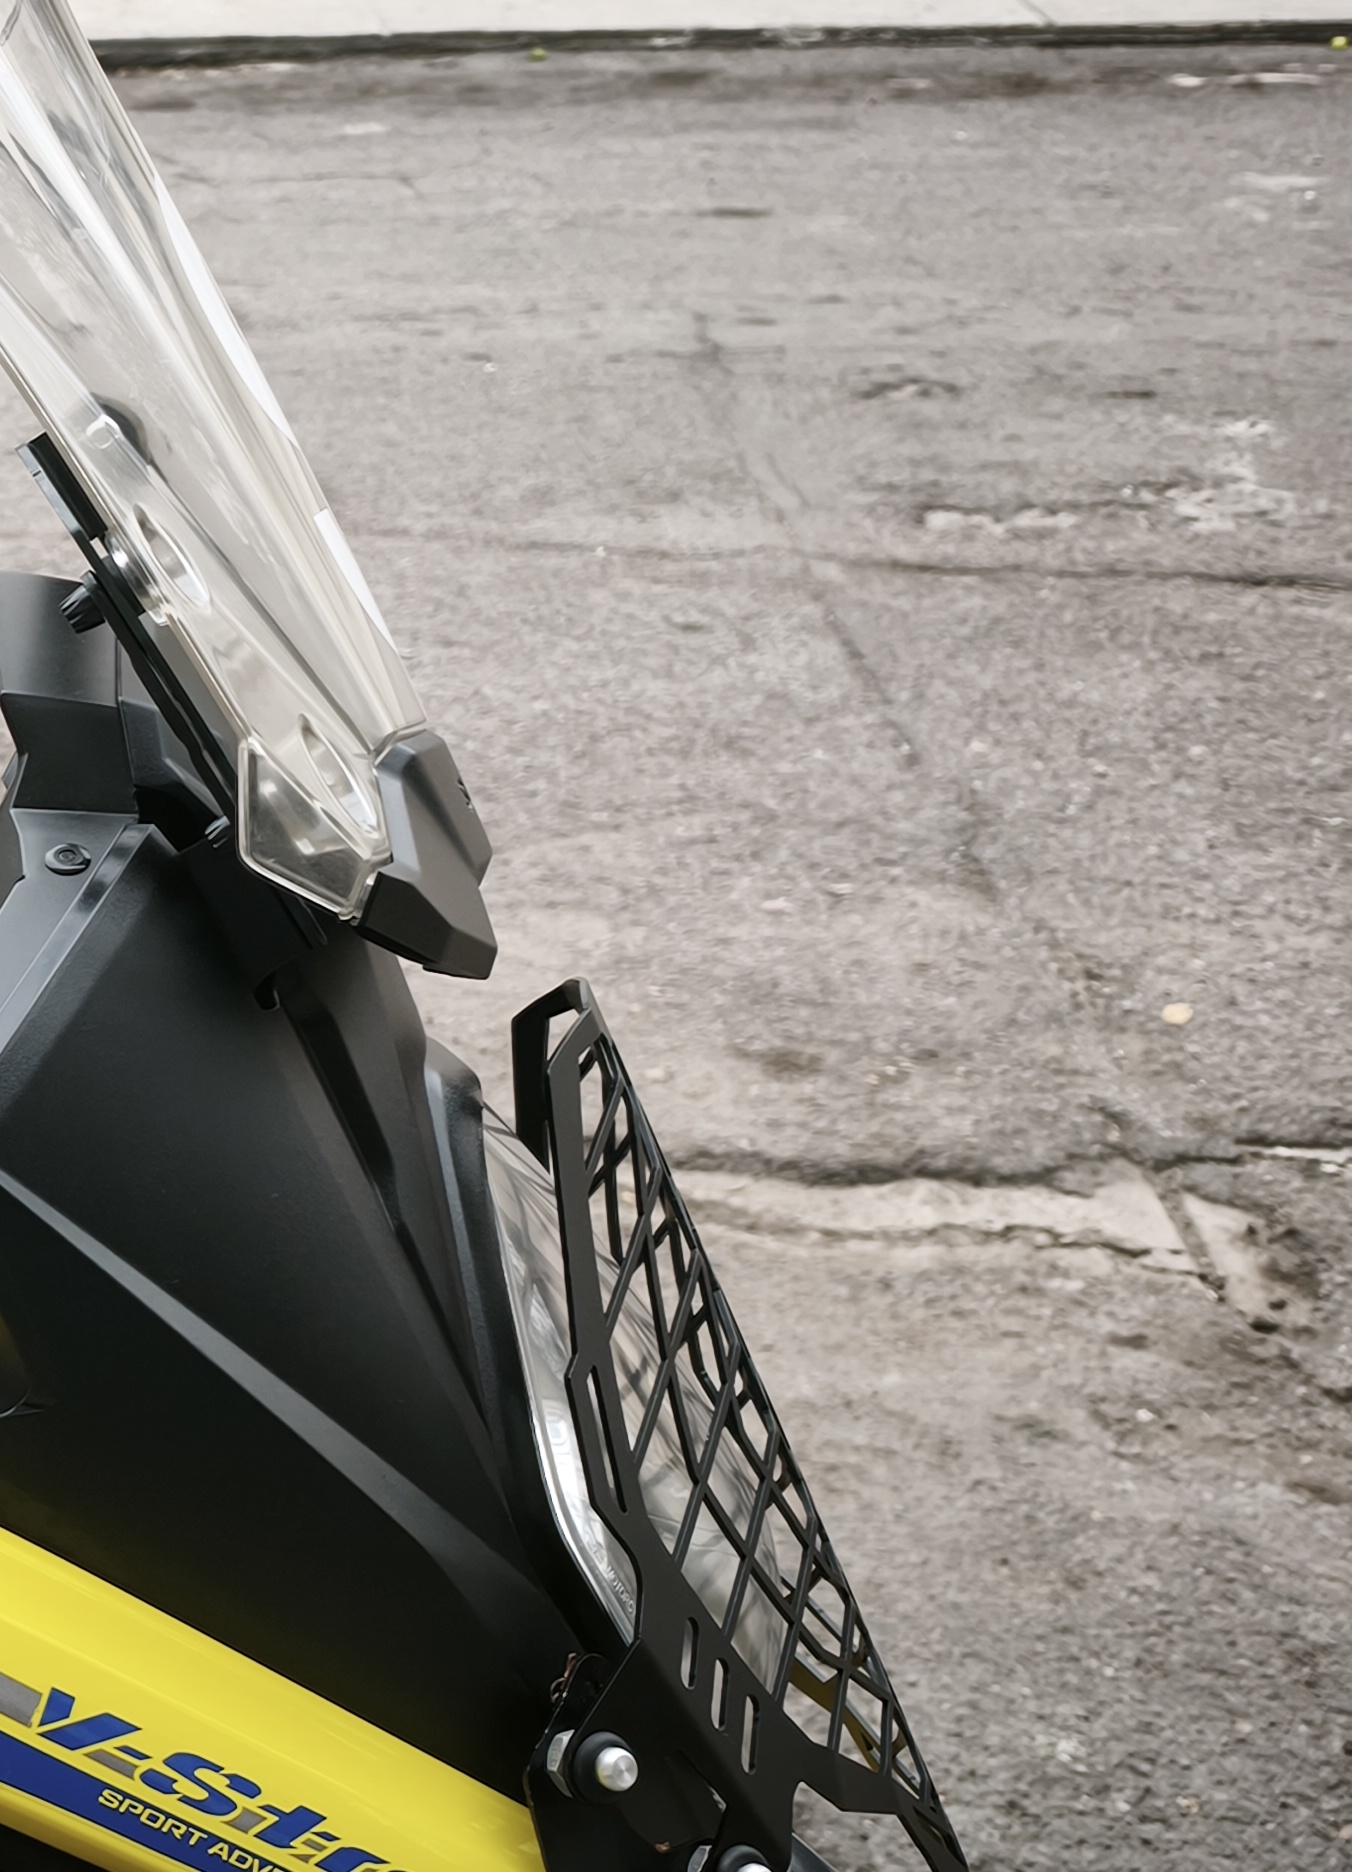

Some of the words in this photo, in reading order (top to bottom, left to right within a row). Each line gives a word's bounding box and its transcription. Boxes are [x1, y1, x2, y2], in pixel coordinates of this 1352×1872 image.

[35, 1686, 408, 1872] V-Str
[97, 1787, 209, 1846] SPORT
[206, 1841, 286, 1872] ADV
